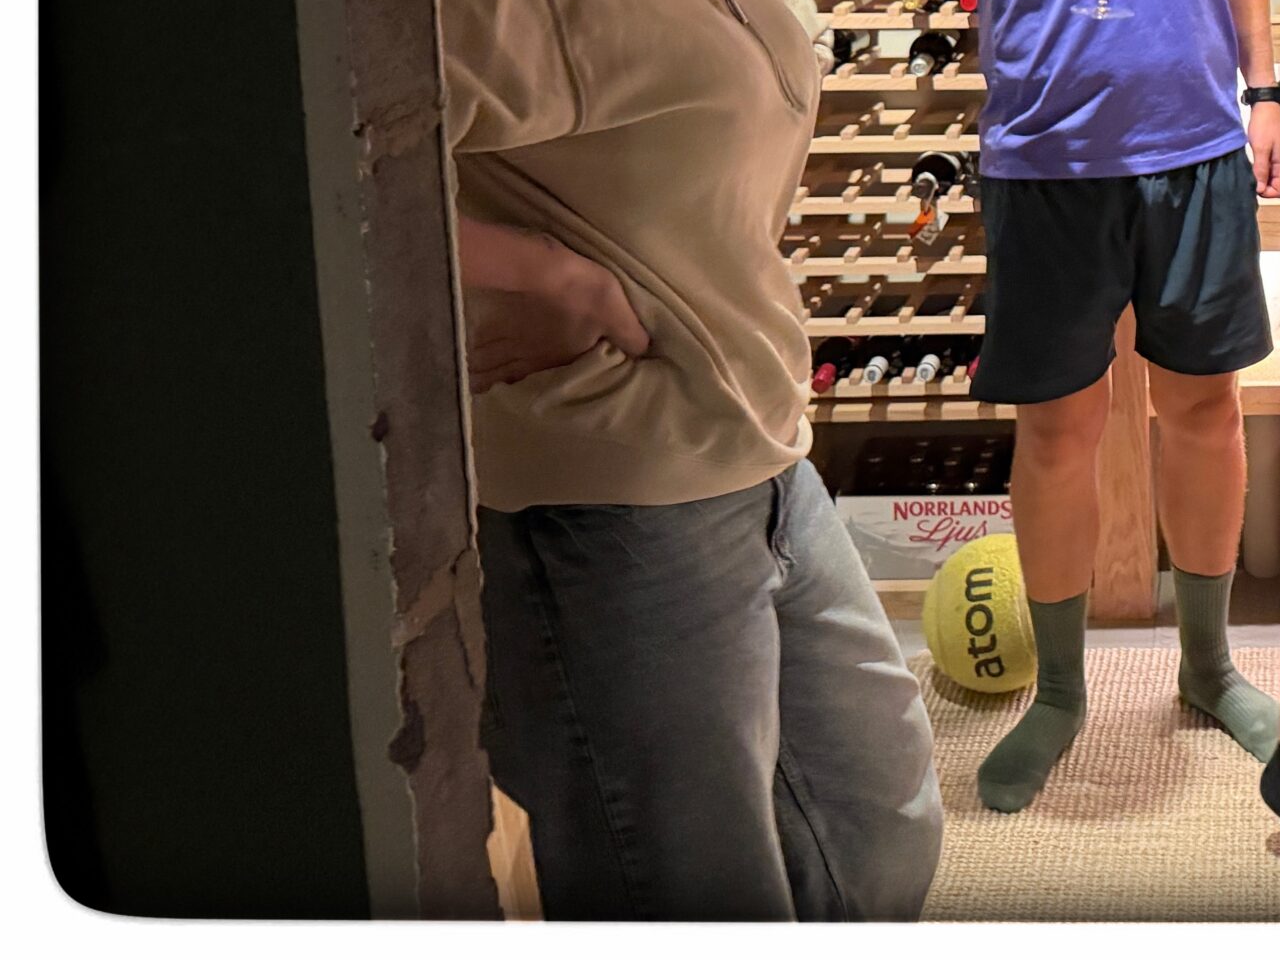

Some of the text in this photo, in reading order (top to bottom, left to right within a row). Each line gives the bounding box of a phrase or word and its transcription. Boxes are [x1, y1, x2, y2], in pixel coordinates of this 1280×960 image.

[893, 500, 1012, 520] NORRLANDS
[909, 517, 987, 551] Ljus
[965, 566, 1005, 678] atom
